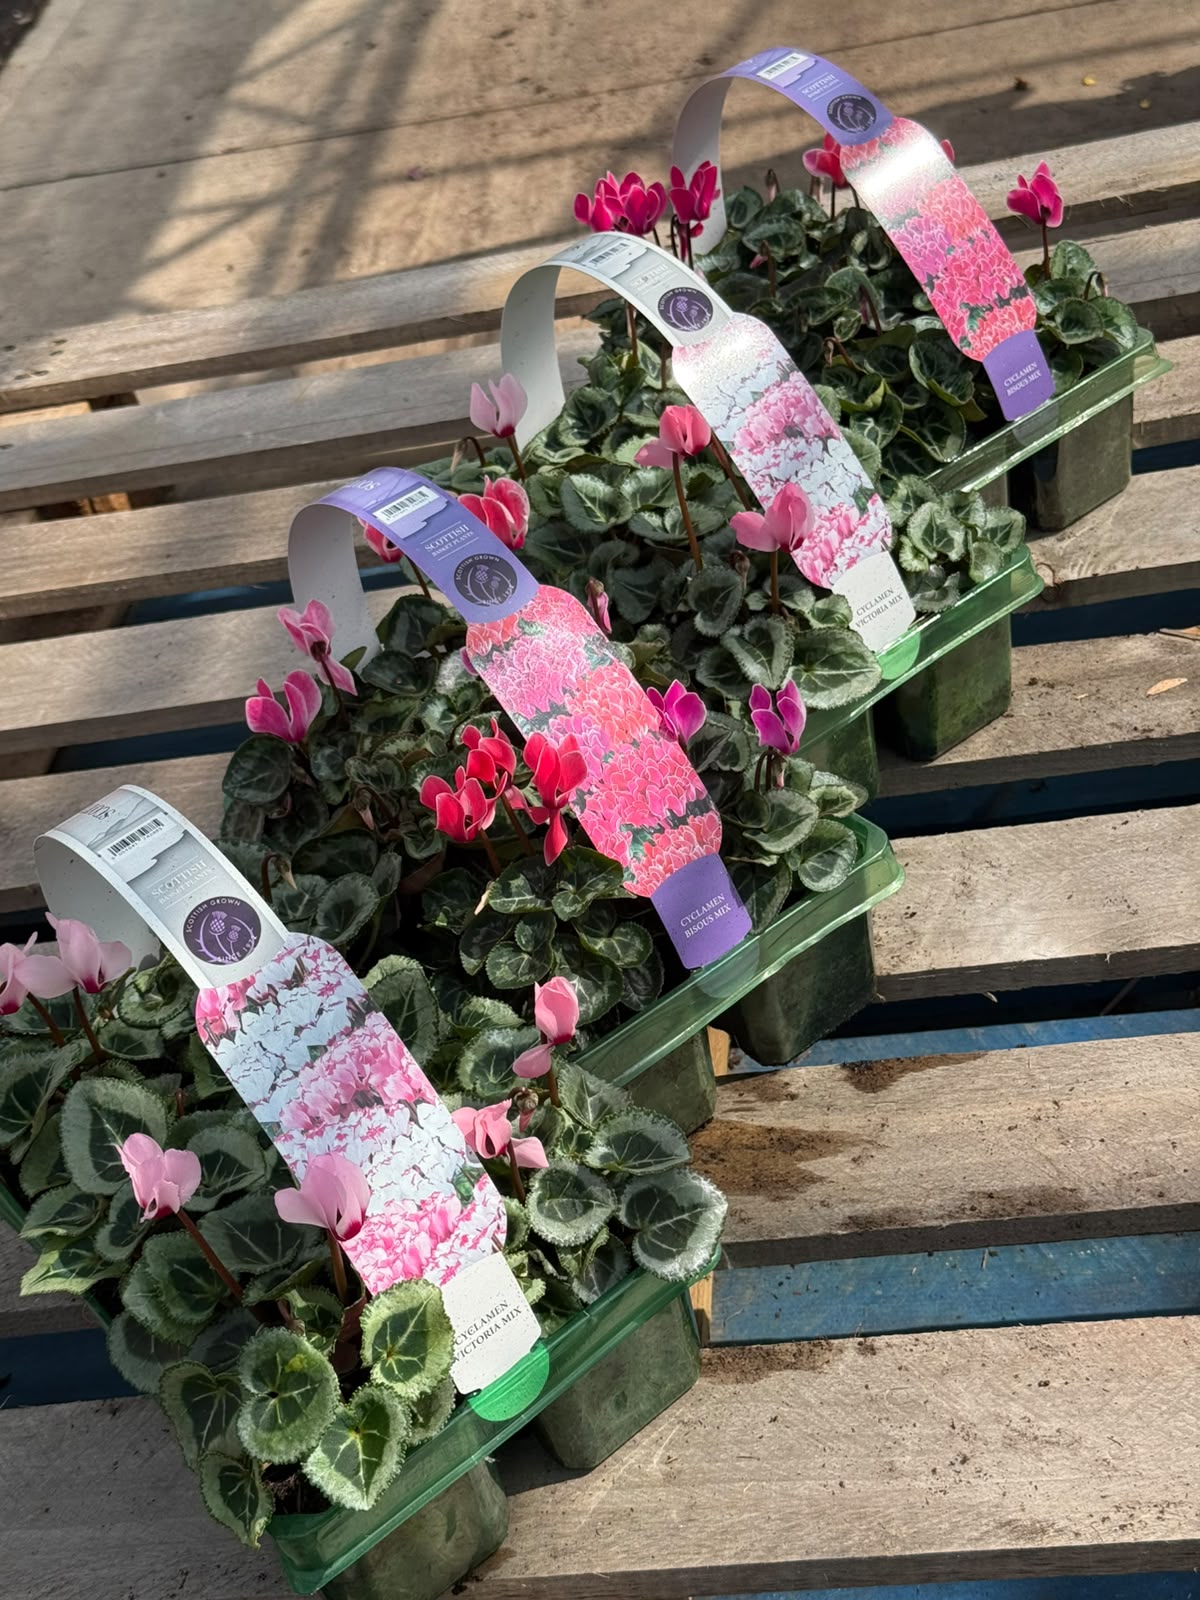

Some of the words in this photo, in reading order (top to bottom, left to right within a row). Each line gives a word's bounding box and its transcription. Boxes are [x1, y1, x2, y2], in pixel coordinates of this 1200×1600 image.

[1003, 361, 1038, 387] CYCLAMEN
[1028, 369, 1042, 383] MIX
[425, 524, 470, 552] SCOTTISH
[456, 558, 473, 580] SCOTTISH
[855, 605, 889, 628] VICTORIA
[888, 593, 904, 608] MIX
[856, 587, 895, 616] CYCLAMEN
[151, 860, 207, 897] SCOTTISH
[186, 904, 208, 933] SCOTTISH
[209, 898, 240, 907] GROWN
[680, 893, 726, 927] CYCLAMEN
[684, 915, 714, 939] BISOUS
[714, 903, 732, 920] MIX
[453, 1323, 501, 1362] VICTORIA
[502, 1305, 522, 1326] MIX
[454, 1299, 509, 1346] CYCLAMEN
